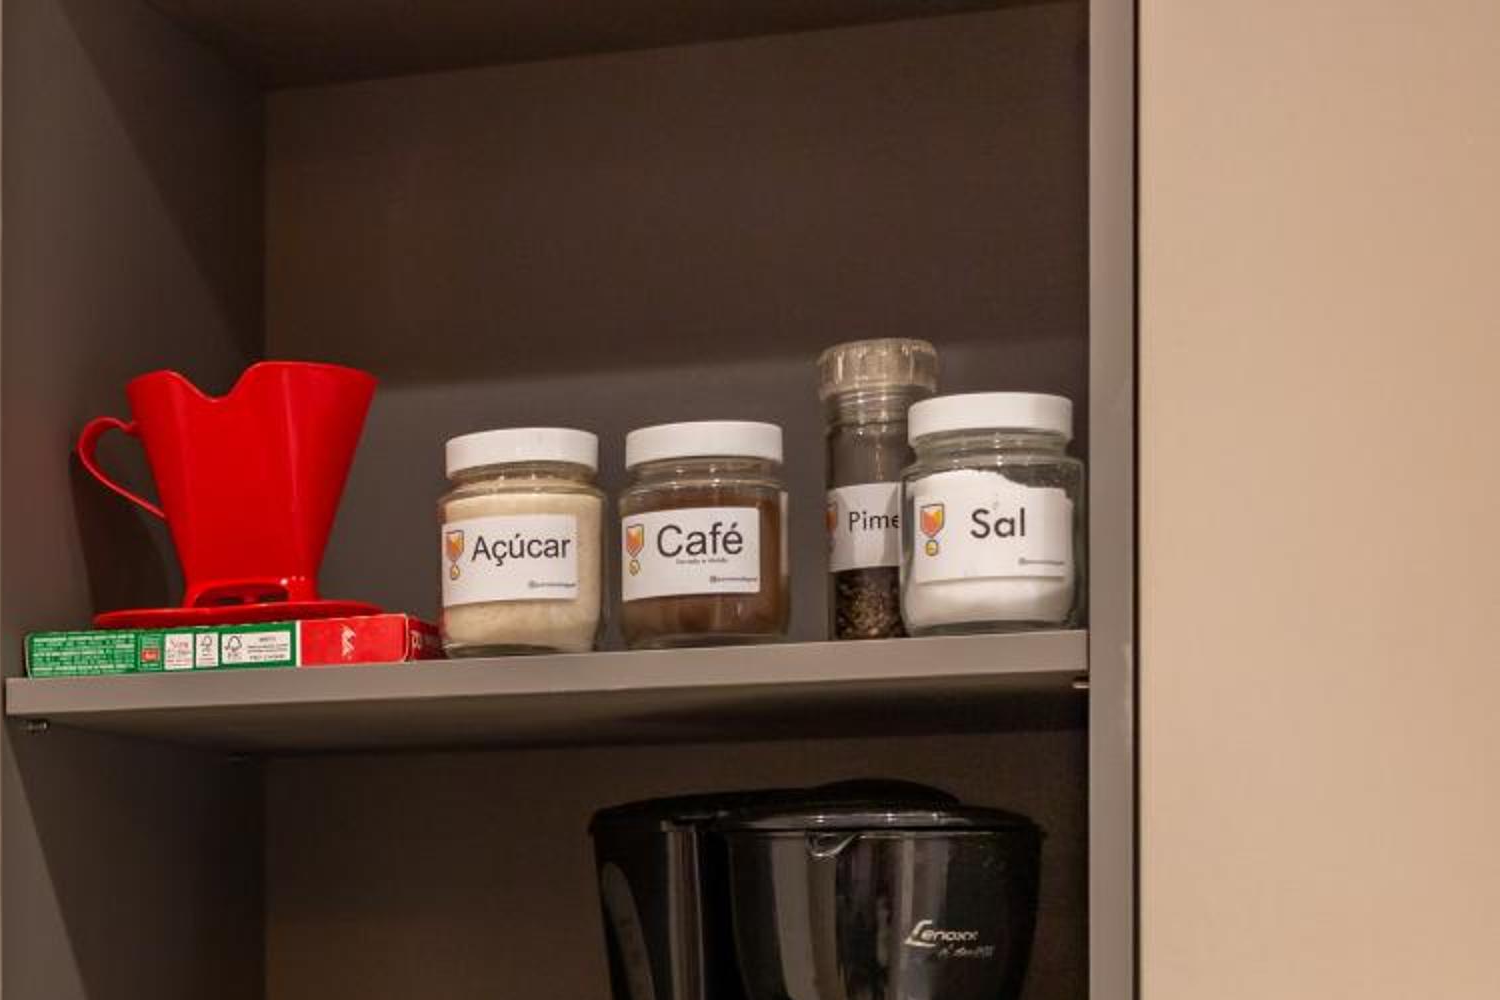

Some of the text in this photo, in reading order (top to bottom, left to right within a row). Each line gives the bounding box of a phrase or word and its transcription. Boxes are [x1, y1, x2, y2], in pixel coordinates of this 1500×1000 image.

[656, 521, 744, 558] Café
[970, 507, 1026, 539] Sal
[471, 532, 571, 567] Açúcar
[904, 919, 979, 947] Lenoxx
